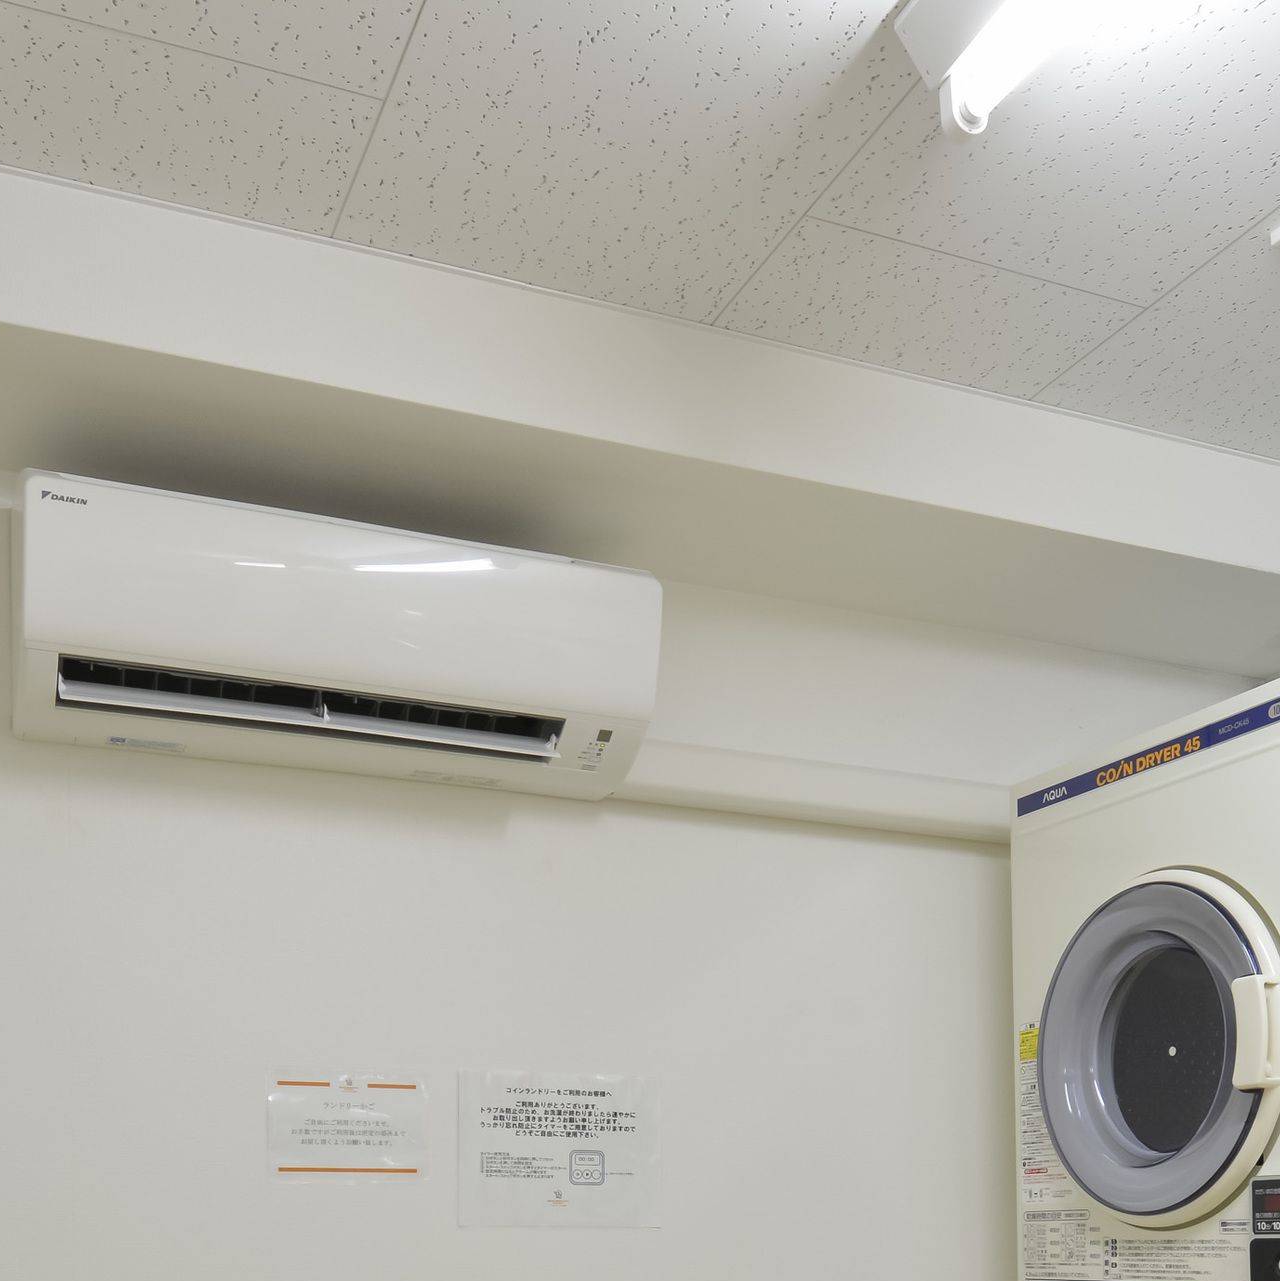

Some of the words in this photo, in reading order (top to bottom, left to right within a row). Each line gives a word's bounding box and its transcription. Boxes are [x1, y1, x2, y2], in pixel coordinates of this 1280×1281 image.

[51, 493, 88, 505] DAIKIN
[1096, 759, 1133, 787] COIN
[1136, 743, 1181, 776] DRYER
[1184, 736, 1201, 753] 45
[1042, 785, 1068, 804] AQUA
[506, 1087, 612, 1097] コインランドリーをご利用のお客様へ
